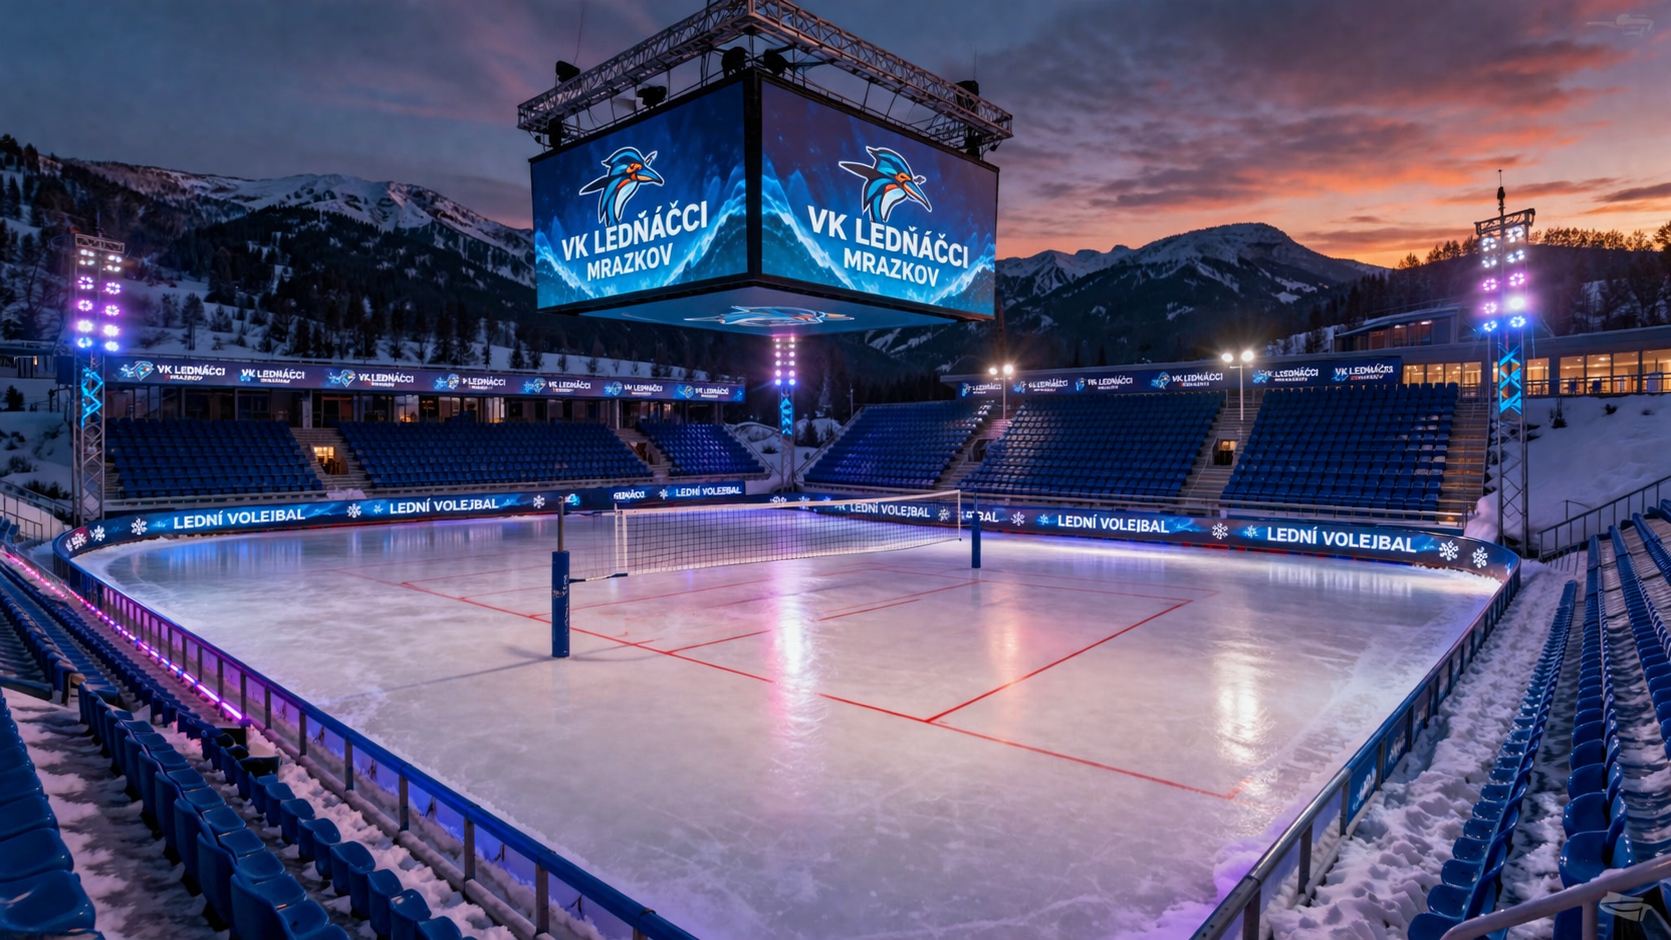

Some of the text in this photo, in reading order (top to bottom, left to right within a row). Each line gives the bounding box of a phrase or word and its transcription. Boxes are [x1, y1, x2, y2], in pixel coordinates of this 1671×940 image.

[561, 200, 708, 262] VK LEDŇÁČCI
[807, 205, 969, 269] VK LEDŇÁČCI
[587, 242, 674, 282] MRAZKOV
[843, 247, 940, 287] MRAZKOV
[157, 364, 173, 374] VK
[389, 497, 499, 514] LEDNÍ VOLEJBAL
[173, 510, 223, 529] LEDNÍ
[1058, 514, 1098, 529] LEDNÍ
[1267, 526, 1417, 553] LEDNÍ VOLEJBAL
